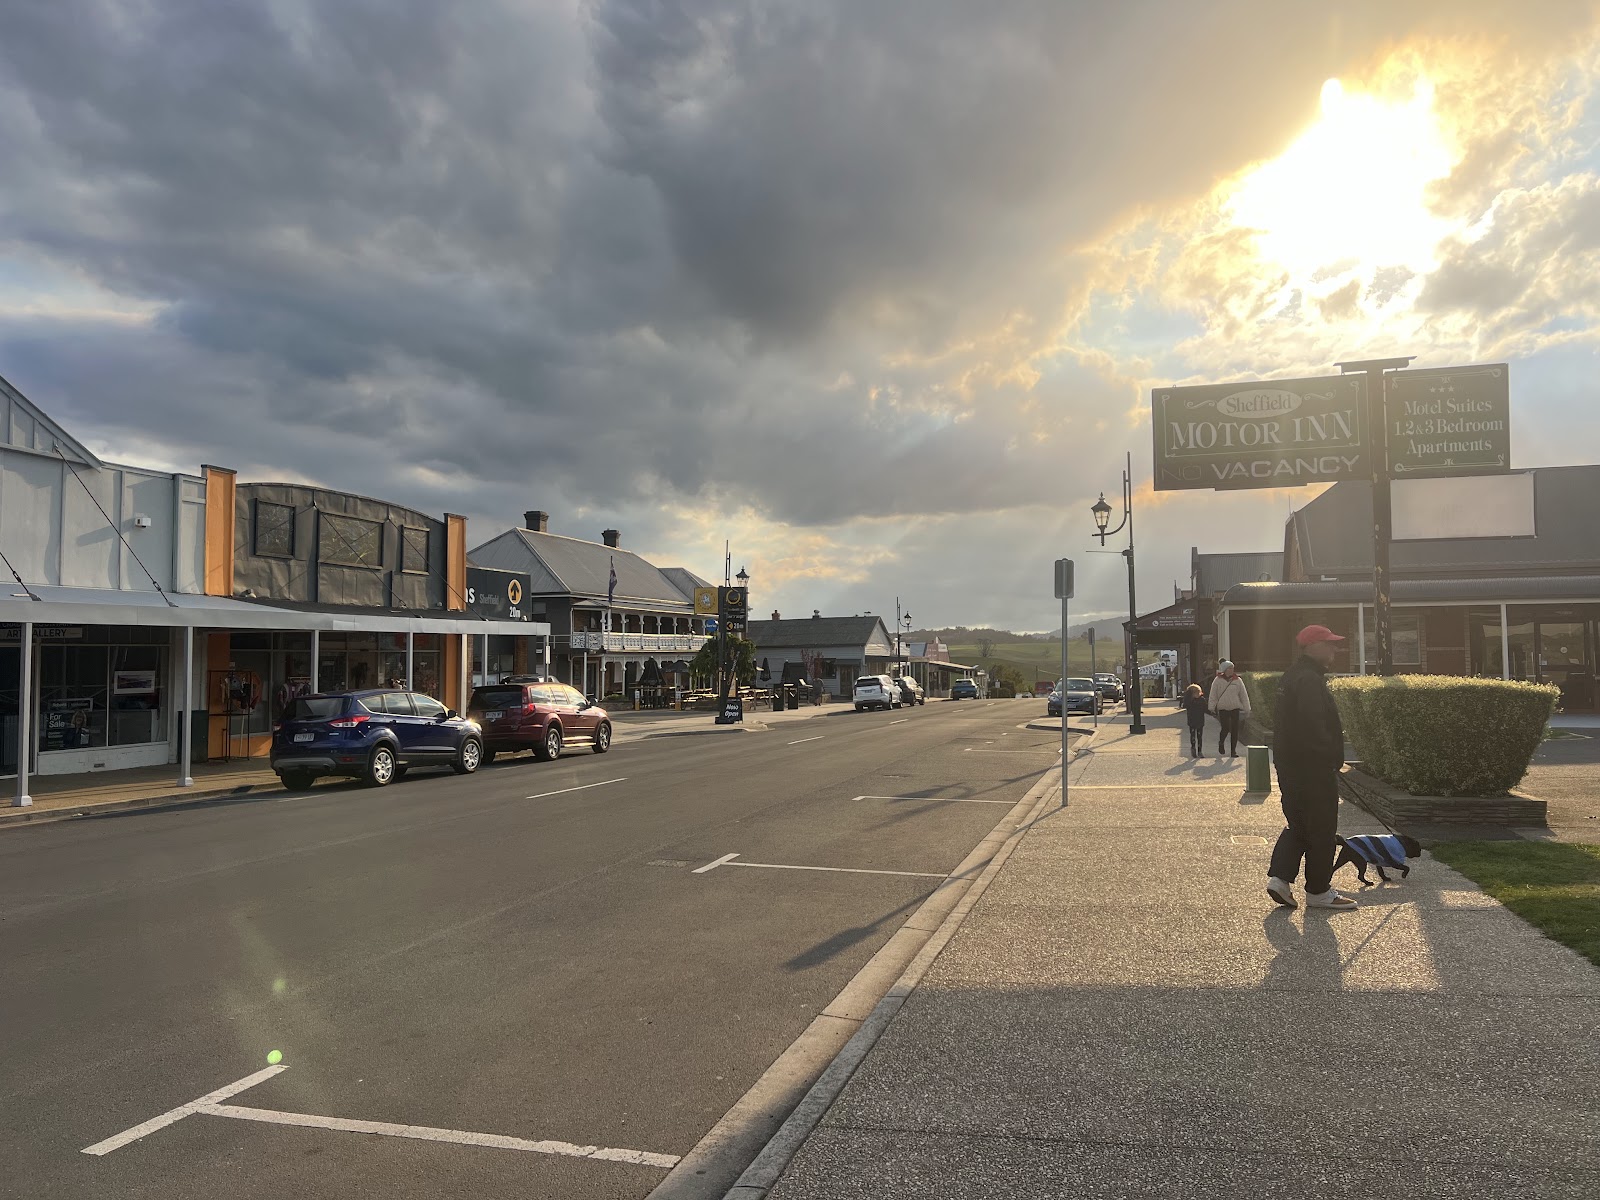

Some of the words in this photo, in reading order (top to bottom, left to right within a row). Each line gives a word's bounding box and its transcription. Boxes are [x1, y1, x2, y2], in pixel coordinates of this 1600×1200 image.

[1226, 394, 1292, 414] Sheffield
[1404, 399, 1442, 416] Motel
[1446, 397, 1493, 414] Suites
[1170, 421, 1283, 450] MOTOR
[1292, 410, 1353, 442] INN
[1436, 417, 1504, 434] Bedroom
[1406, 438, 1493, 457] Apartments
[1211, 454, 1360, 480] VACANCY
[479, 593, 499, 605] Sheffield
[509, 606, 521, 618] 20m
[7, 629, 21, 638] ART
[32, 628, 67, 637] ALLERY
[49, 712, 61, 721] For
[724, 710, 739, 718] Open
[48, 720, 65, 728] Sale
